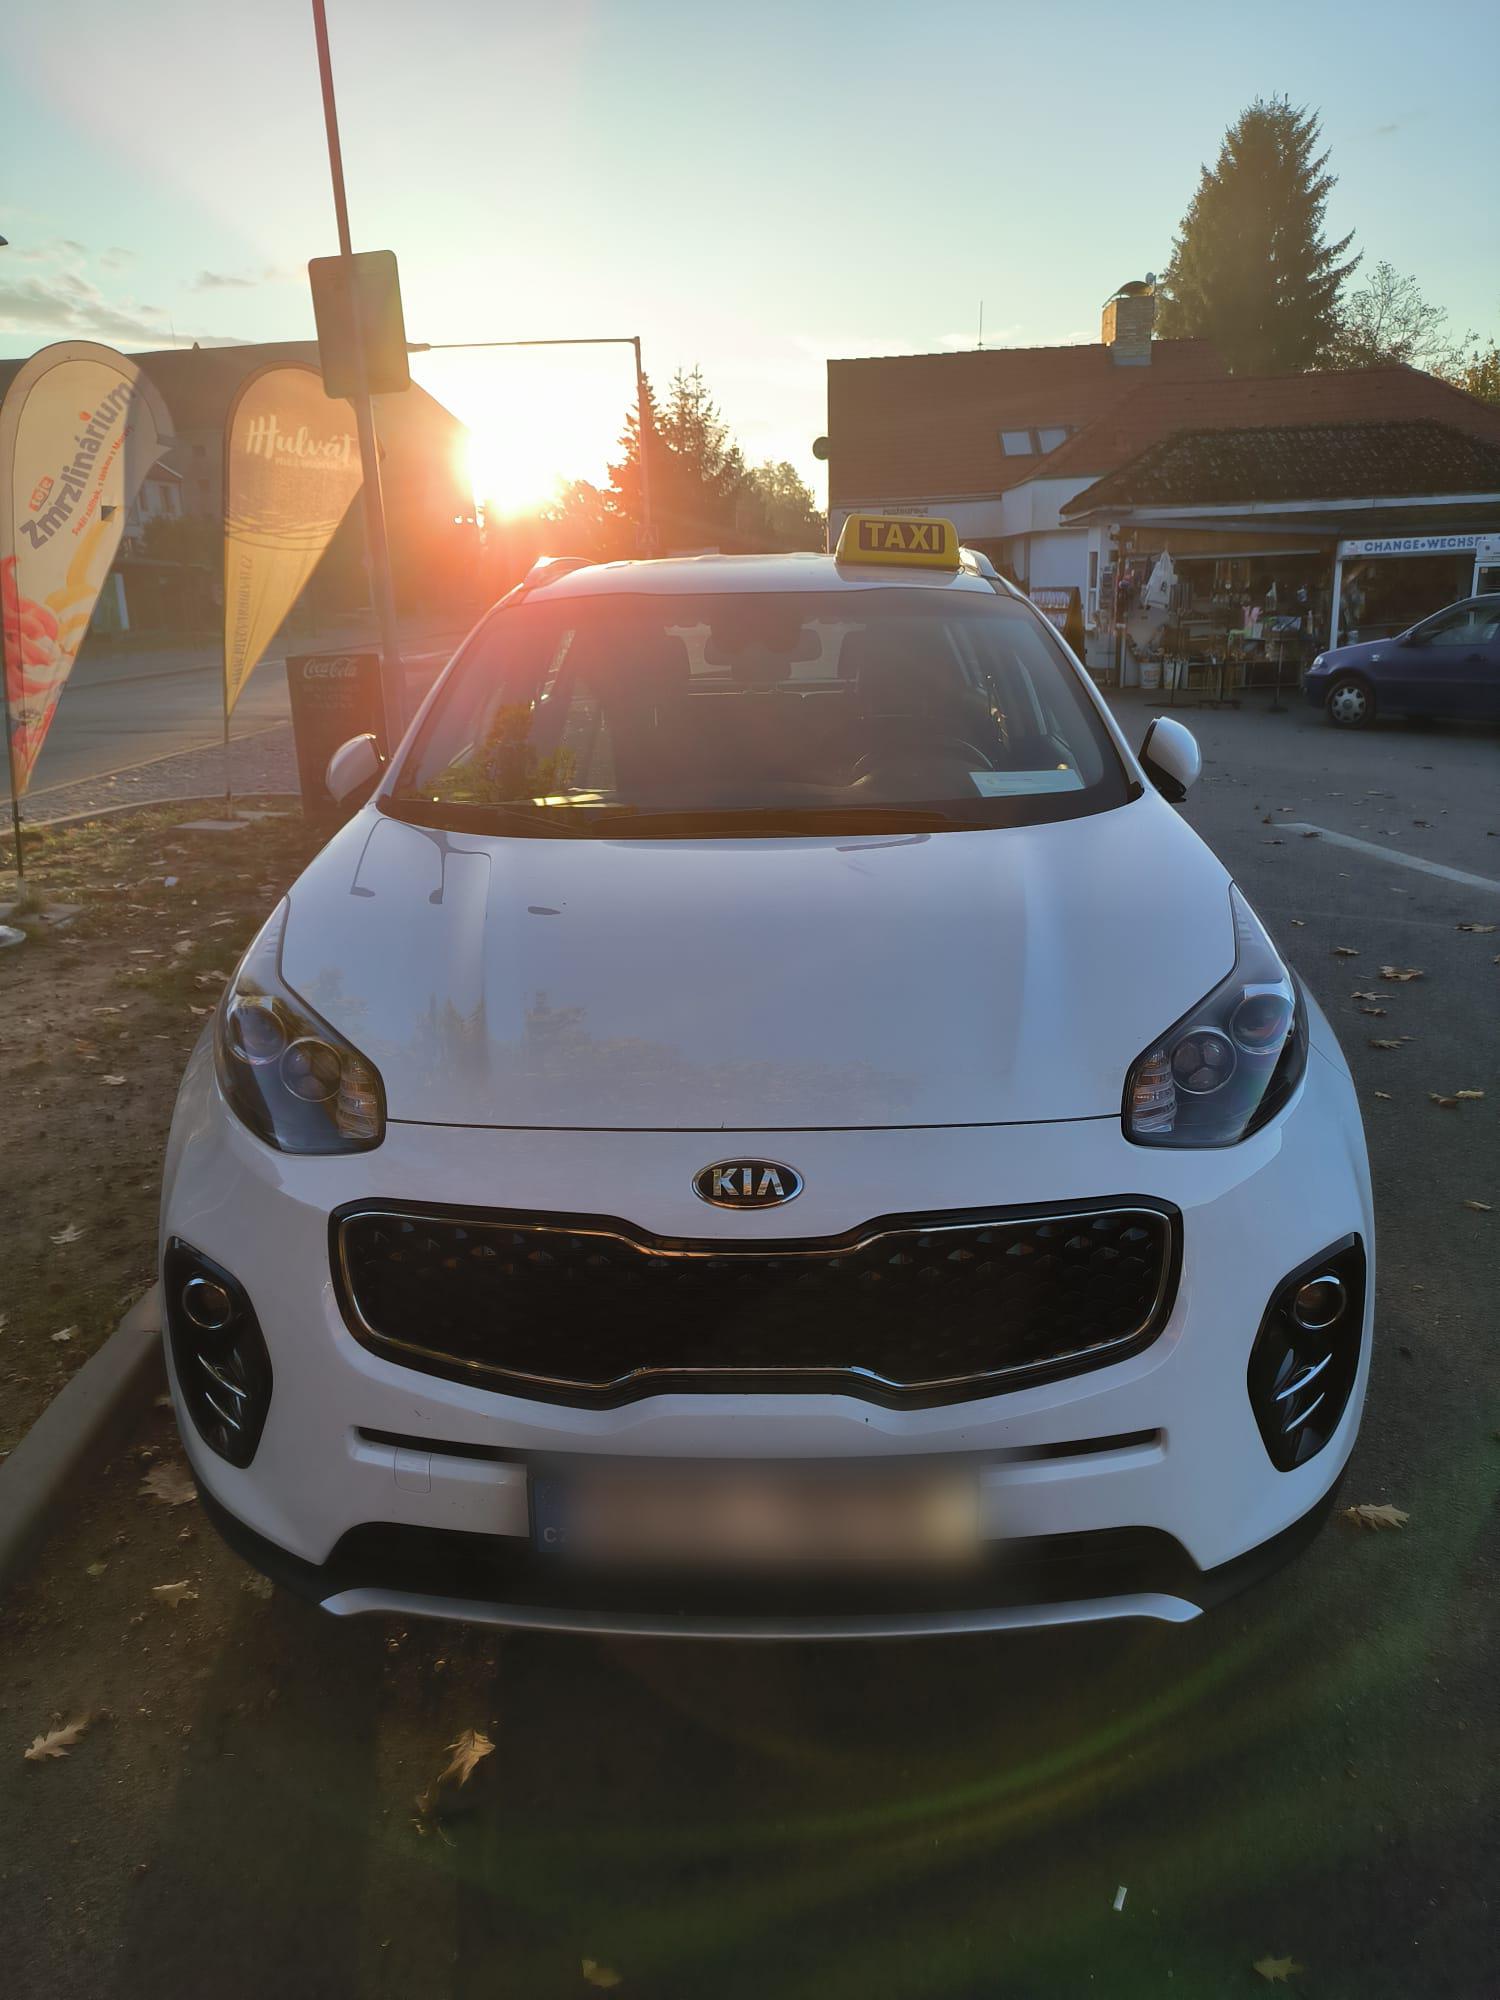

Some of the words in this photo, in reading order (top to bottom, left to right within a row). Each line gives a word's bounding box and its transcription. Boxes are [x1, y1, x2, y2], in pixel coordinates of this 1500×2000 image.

[19, 382, 136, 550] Zmrzlinárium
[864, 522, 940, 551] TAXI
[712, 1167, 785, 1196] KIA
